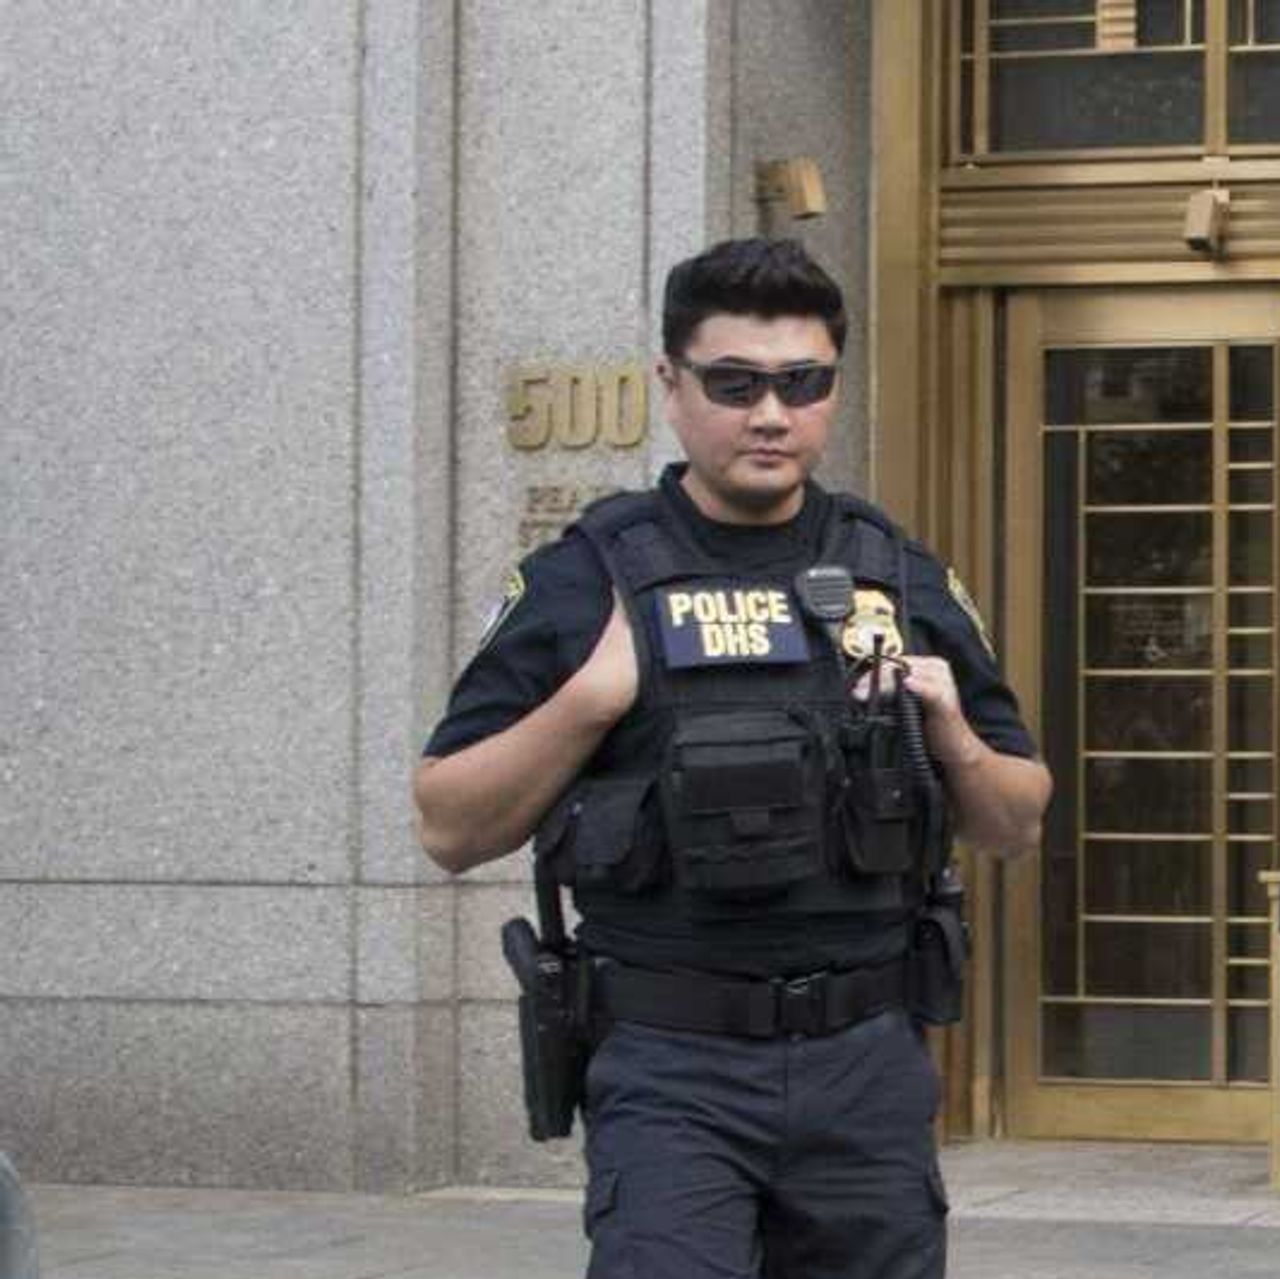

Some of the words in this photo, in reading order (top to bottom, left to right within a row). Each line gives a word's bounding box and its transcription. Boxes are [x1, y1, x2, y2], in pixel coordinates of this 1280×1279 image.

[505, 366, 648, 450] 500
[667, 589, 793, 628] POLICE
[701, 622, 772, 657] DHS
